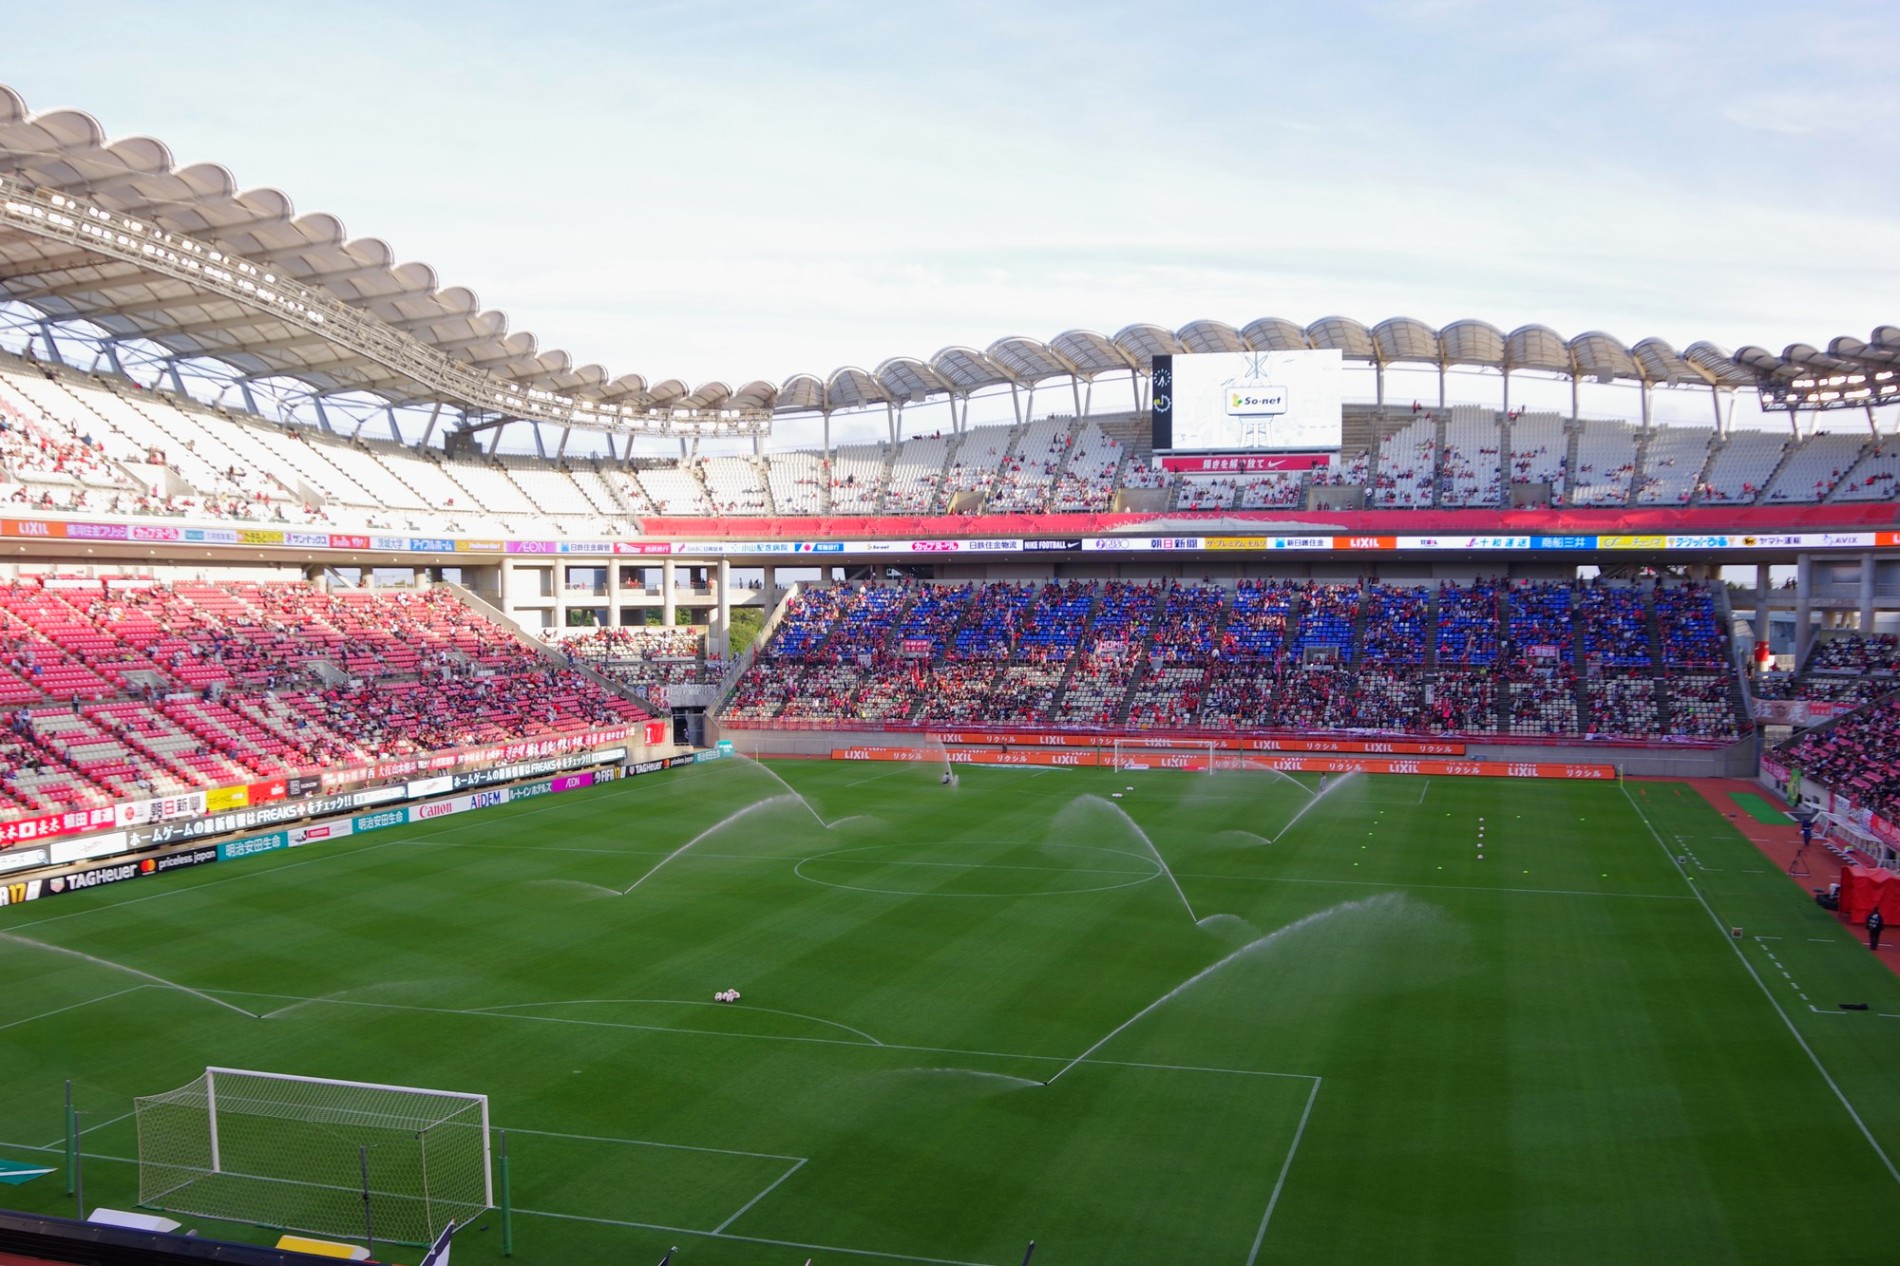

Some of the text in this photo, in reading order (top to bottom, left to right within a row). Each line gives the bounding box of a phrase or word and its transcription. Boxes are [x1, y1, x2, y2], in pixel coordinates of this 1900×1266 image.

[1245, 396, 1281, 405] So-net
[1202, 459, 1264, 470] 輝きを解放て
[18, 522, 48, 535] LIXIL
[914, 542, 957, 551] カップヌードル
[969, 542, 1017, 550] 日鉄住金物流
[1024, 540, 1066, 549] NIKE FOOTBALL
[1151, 538, 1198, 548] 朝日新聞
[1350, 538, 1380, 548] LIXIL
[1542, 538, 1586, 548] 商船三井
[1759, 536, 1802, 544] ヤマト運輸
[1100, 640, 1125, 648] HOME
[986, 735, 1016, 743] リクシル
[1040, 736, 1066, 744] LIXIL
[1090, 737, 1120, 746] リクシル
[1145, 738, 1172, 746] LIXIL
[1253, 740, 1281, 750] LIXIL
[1306, 742, 1338, 750] リクシル
[1364, 743, 1393, 752] LIXIL
[1419, 744, 1452, 753] リクシル
[844, 750, 870, 760] LIXIL
[893, 752, 922, 760] リクシル
[948, 752, 972, 762] LIXIL
[996, 754, 1027, 762] リクシル
[1052, 755, 1080, 764] LIXIL
[1104, 756, 1136, 765] リクシル
[1162, 758, 1188, 767] LIXIL
[1274, 761, 1302, 770] LIXIL
[1328, 762, 1362, 771] リクシル
[1389, 764, 1418, 773] LIXIL
[1446, 766, 1480, 774] リクシル
[1508, 767, 1539, 776] LIXIL
[1566, 768, 1602, 778] リクシル
[601, 768, 614, 782] FIFA
[151, 796, 200, 818] 朝日新聞
[420, 802, 452, 818] Canon
[129, 812, 256, 846] ホームゲームの最新情報は
[307, 794, 352, 814] をチェック!!
[358, 810, 404, 830] 明治安田生命
[225, 835, 281, 858] 明治安田生命
[158, 849, 216, 870] priceless japan
[8, 882, 26, 904] 17
